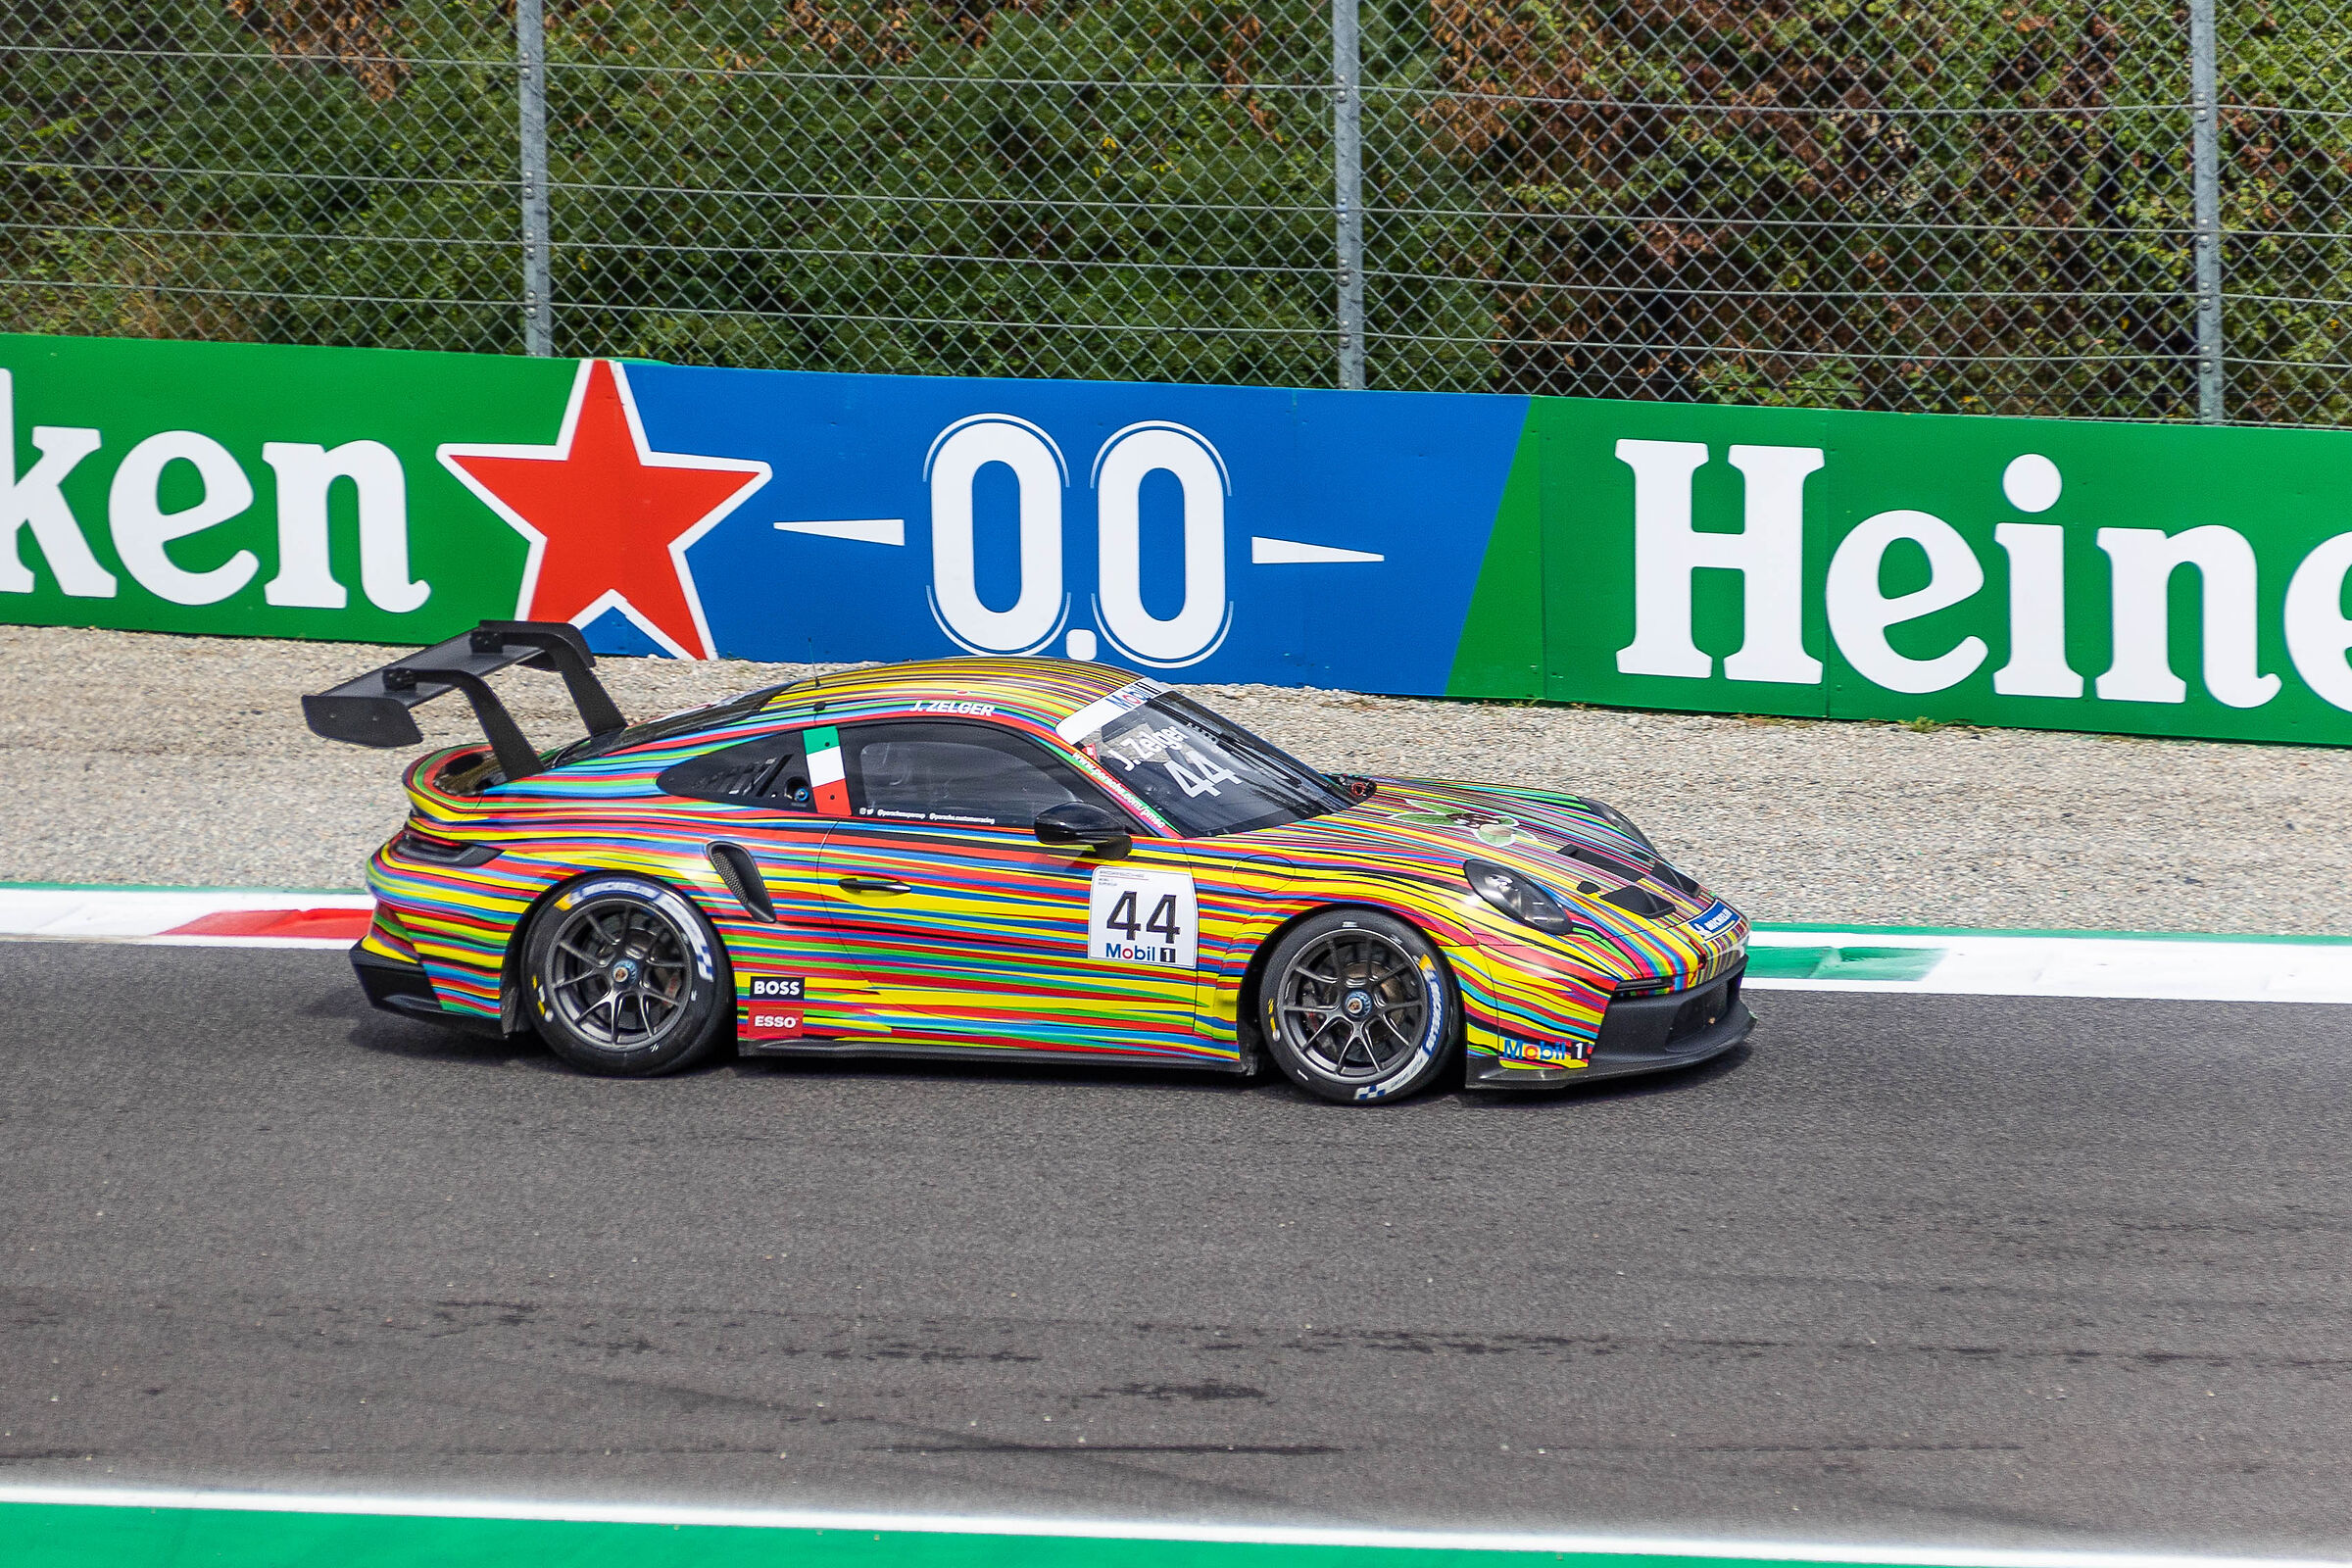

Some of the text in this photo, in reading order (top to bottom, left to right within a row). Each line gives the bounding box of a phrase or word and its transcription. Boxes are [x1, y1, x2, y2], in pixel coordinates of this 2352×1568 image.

[923, 412, 1233, 669] 0.0
[908, 700, 995, 716] J. ZELGER
[1163, 750, 1243, 798] 44
[1106, 890, 1181, 945] 44
[1105, 942, 1173, 962] Mobil 1
[754, 980, 801, 996] BOSS
[754, 1014, 797, 1029] ESSO
[1503, 1039, 1567, 1061] Mobil
